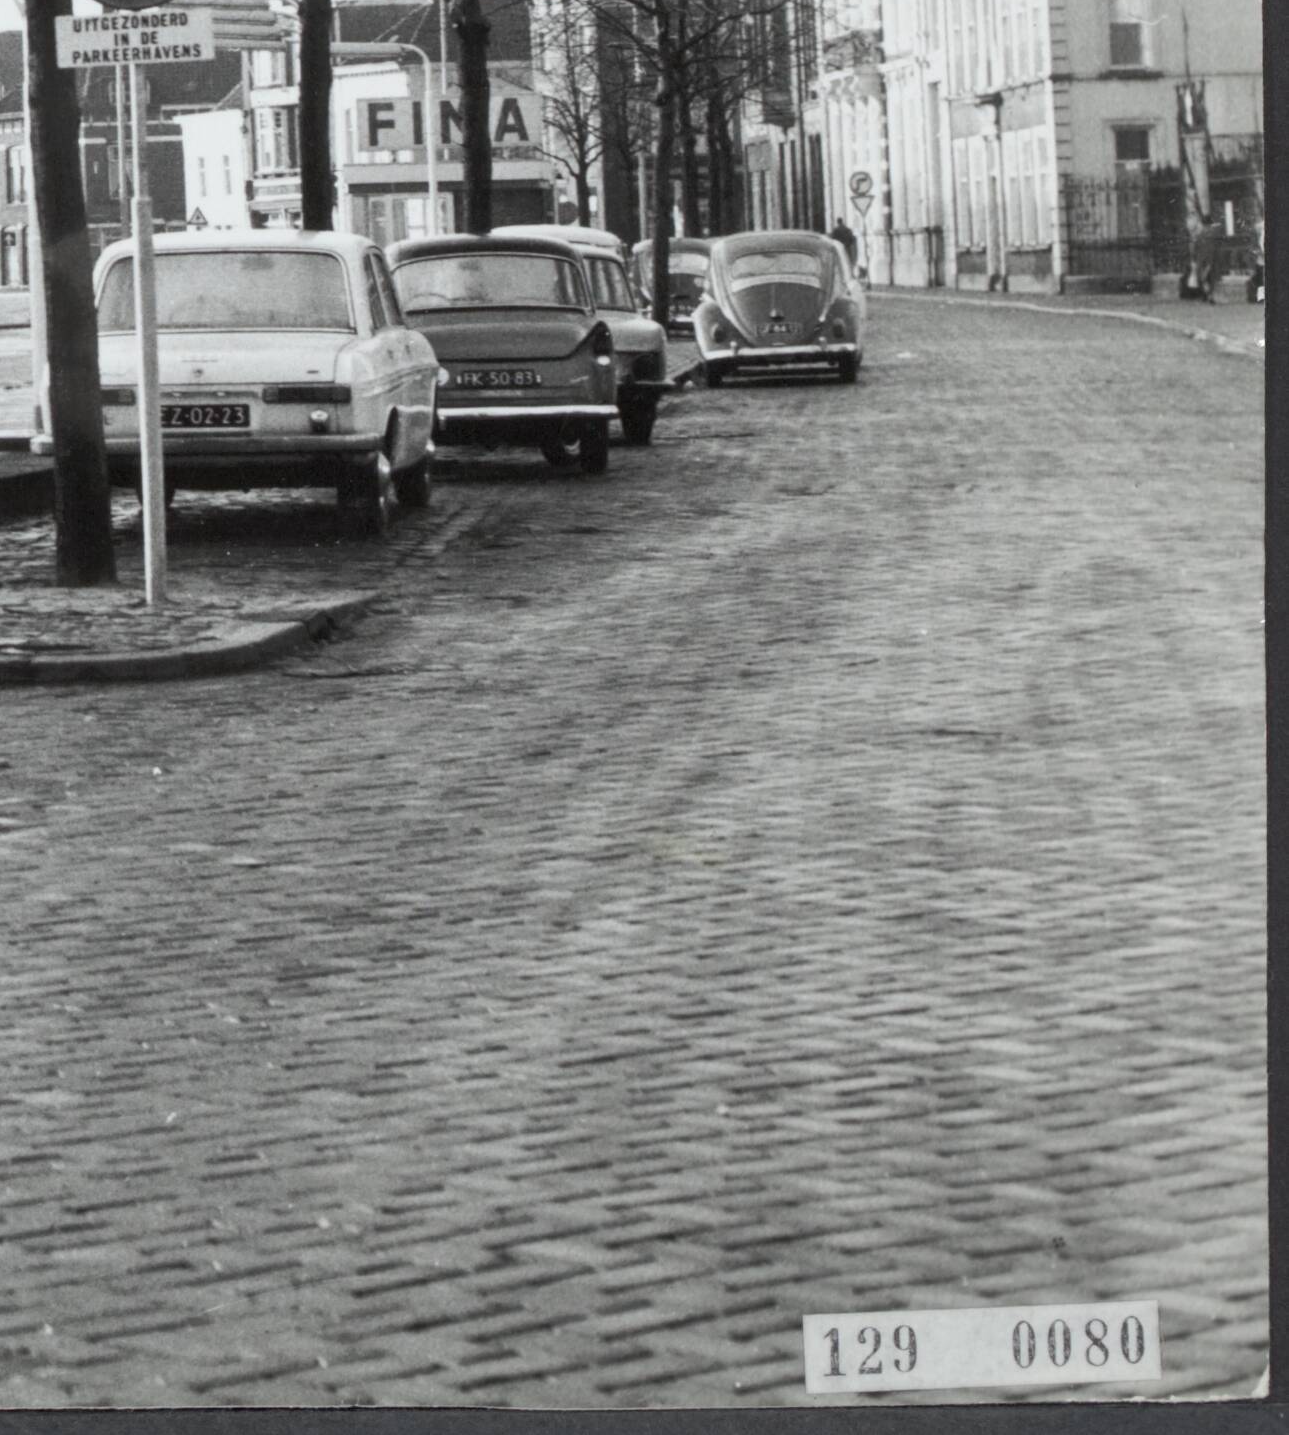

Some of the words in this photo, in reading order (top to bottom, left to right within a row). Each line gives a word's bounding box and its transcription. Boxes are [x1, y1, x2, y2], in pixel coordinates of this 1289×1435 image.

[72, 12, 188, 33] UITGEZONDERD
[114, 32, 130, 47] IN
[140, 30, 159, 45] DE
[72, 44, 201, 64] PARKEERHAVENS
[368, 97, 530, 147] FINA
